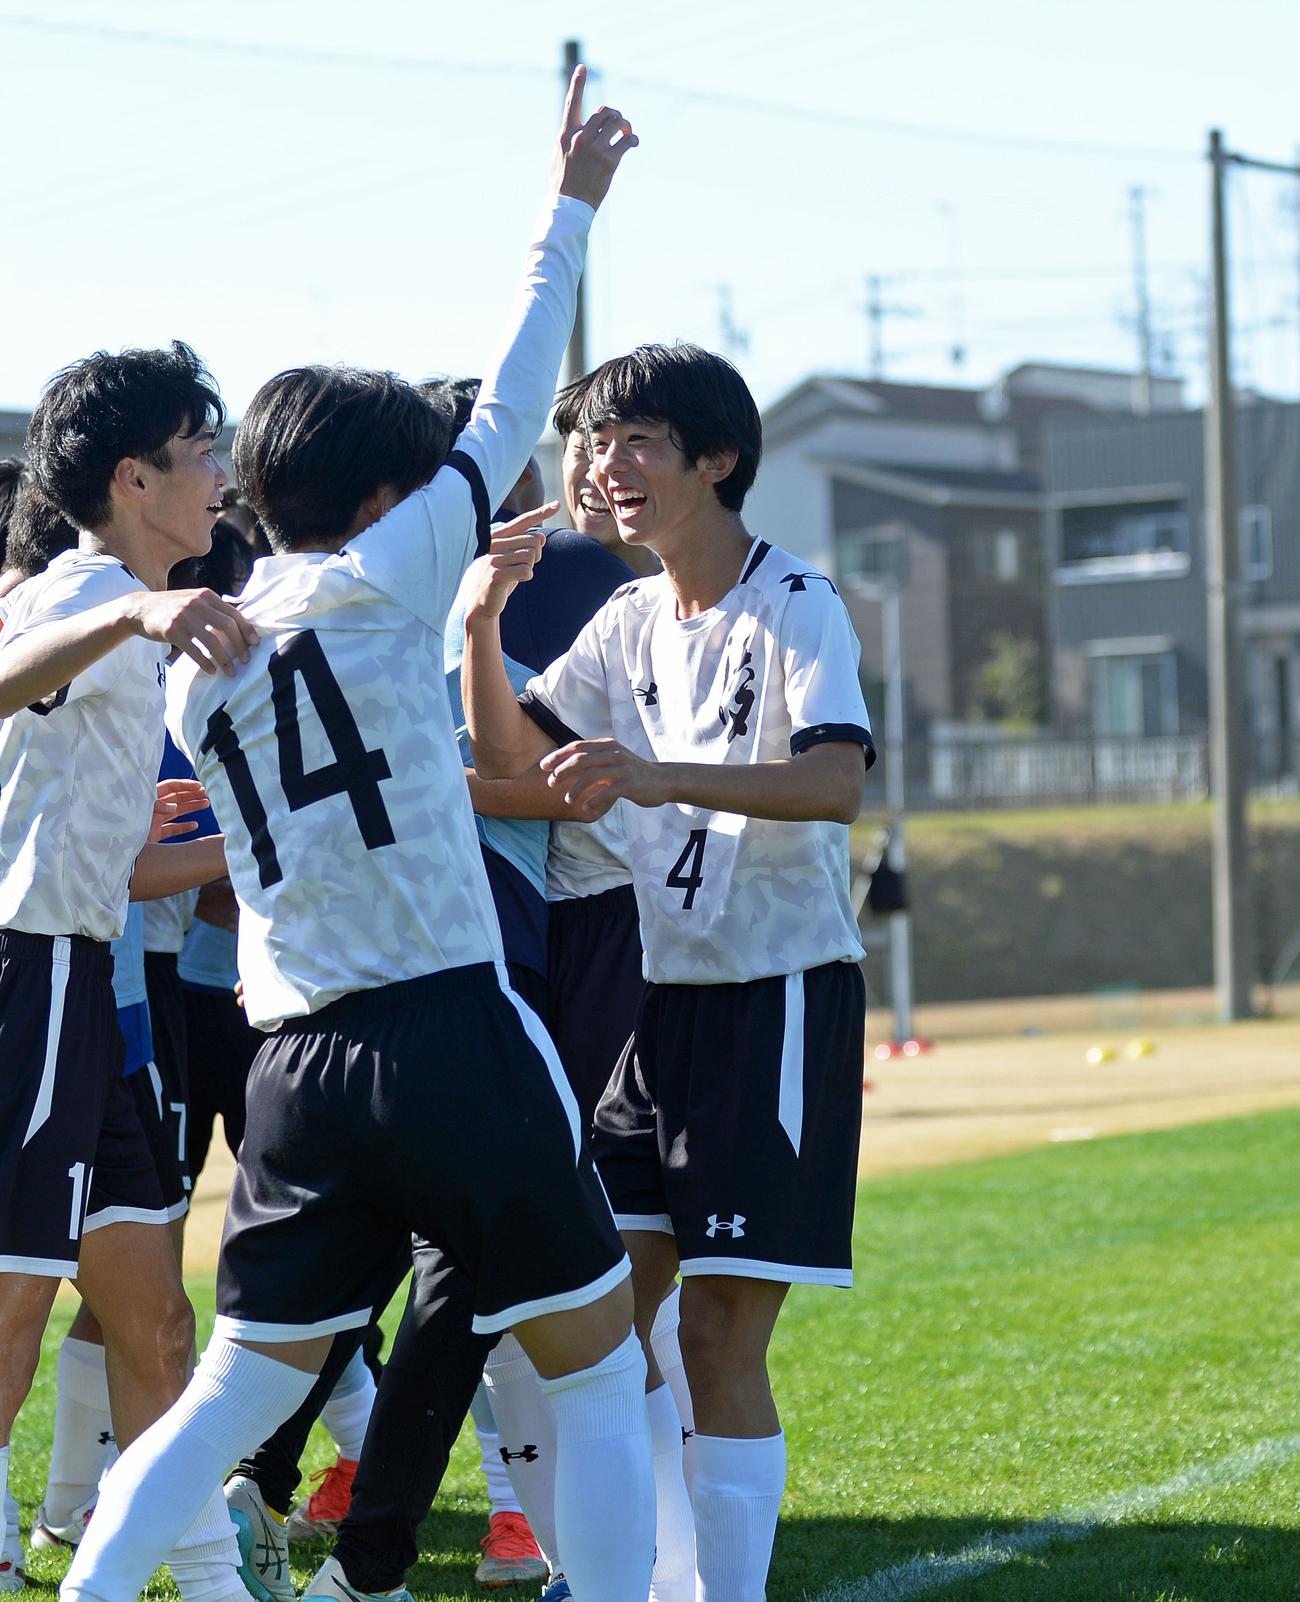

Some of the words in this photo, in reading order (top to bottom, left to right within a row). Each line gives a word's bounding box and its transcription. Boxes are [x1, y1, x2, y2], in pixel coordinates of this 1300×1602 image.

[201, 628, 397, 889] 14
[665, 828, 708, 910] 4
[68, 1161, 94, 1241] 1
